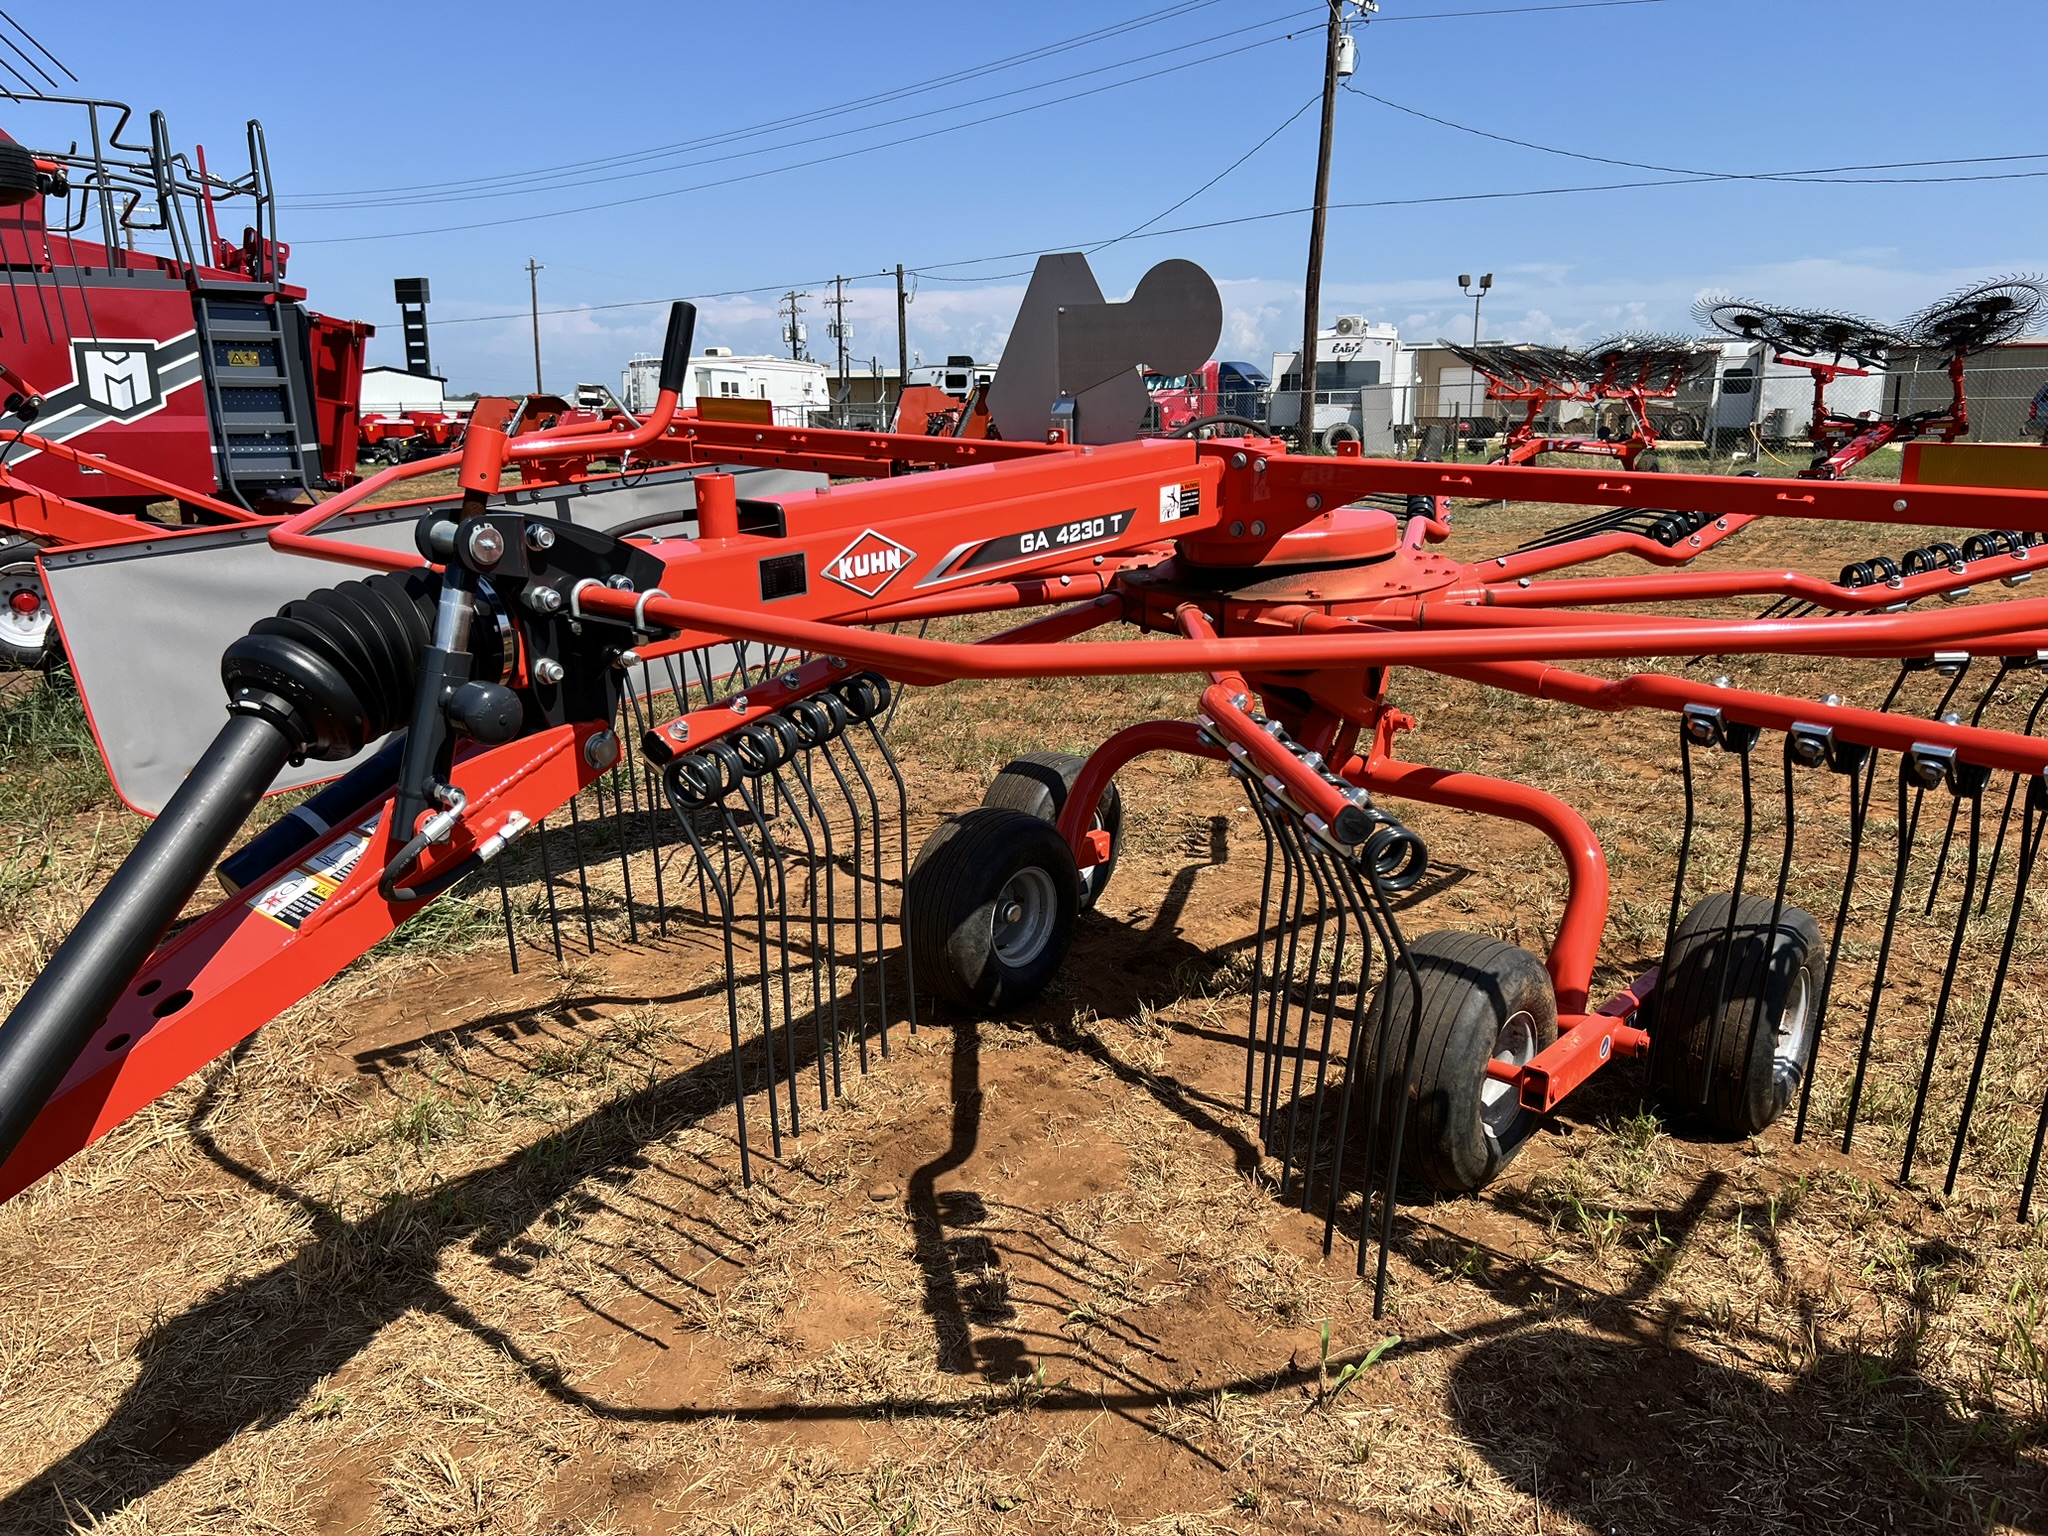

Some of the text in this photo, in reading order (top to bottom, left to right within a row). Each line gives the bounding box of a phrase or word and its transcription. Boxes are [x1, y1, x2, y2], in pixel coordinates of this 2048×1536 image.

[1020, 514, 1122, 553] GA 4230 T
[838, 548, 901, 580] KUHN
